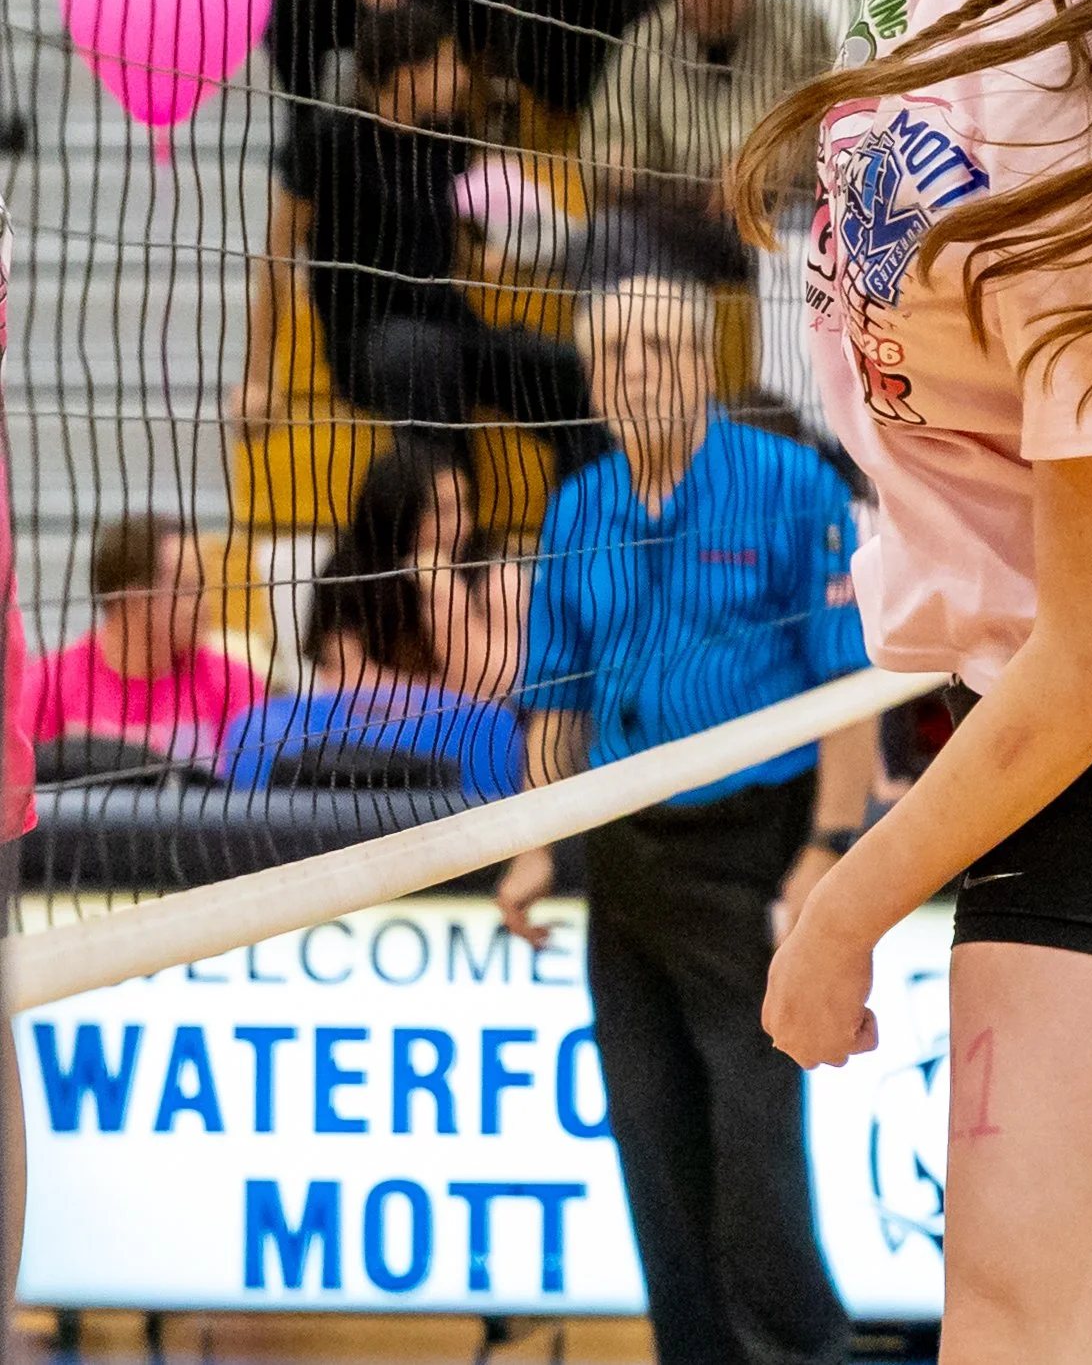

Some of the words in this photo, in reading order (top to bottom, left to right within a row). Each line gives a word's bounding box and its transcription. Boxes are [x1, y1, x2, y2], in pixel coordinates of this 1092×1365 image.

[887, 108, 990, 212] MOTT
[805, 282, 836, 318] URT.
[148, 918, 577, 985] LCOME
[243, 1179, 587, 1292] MOTT
